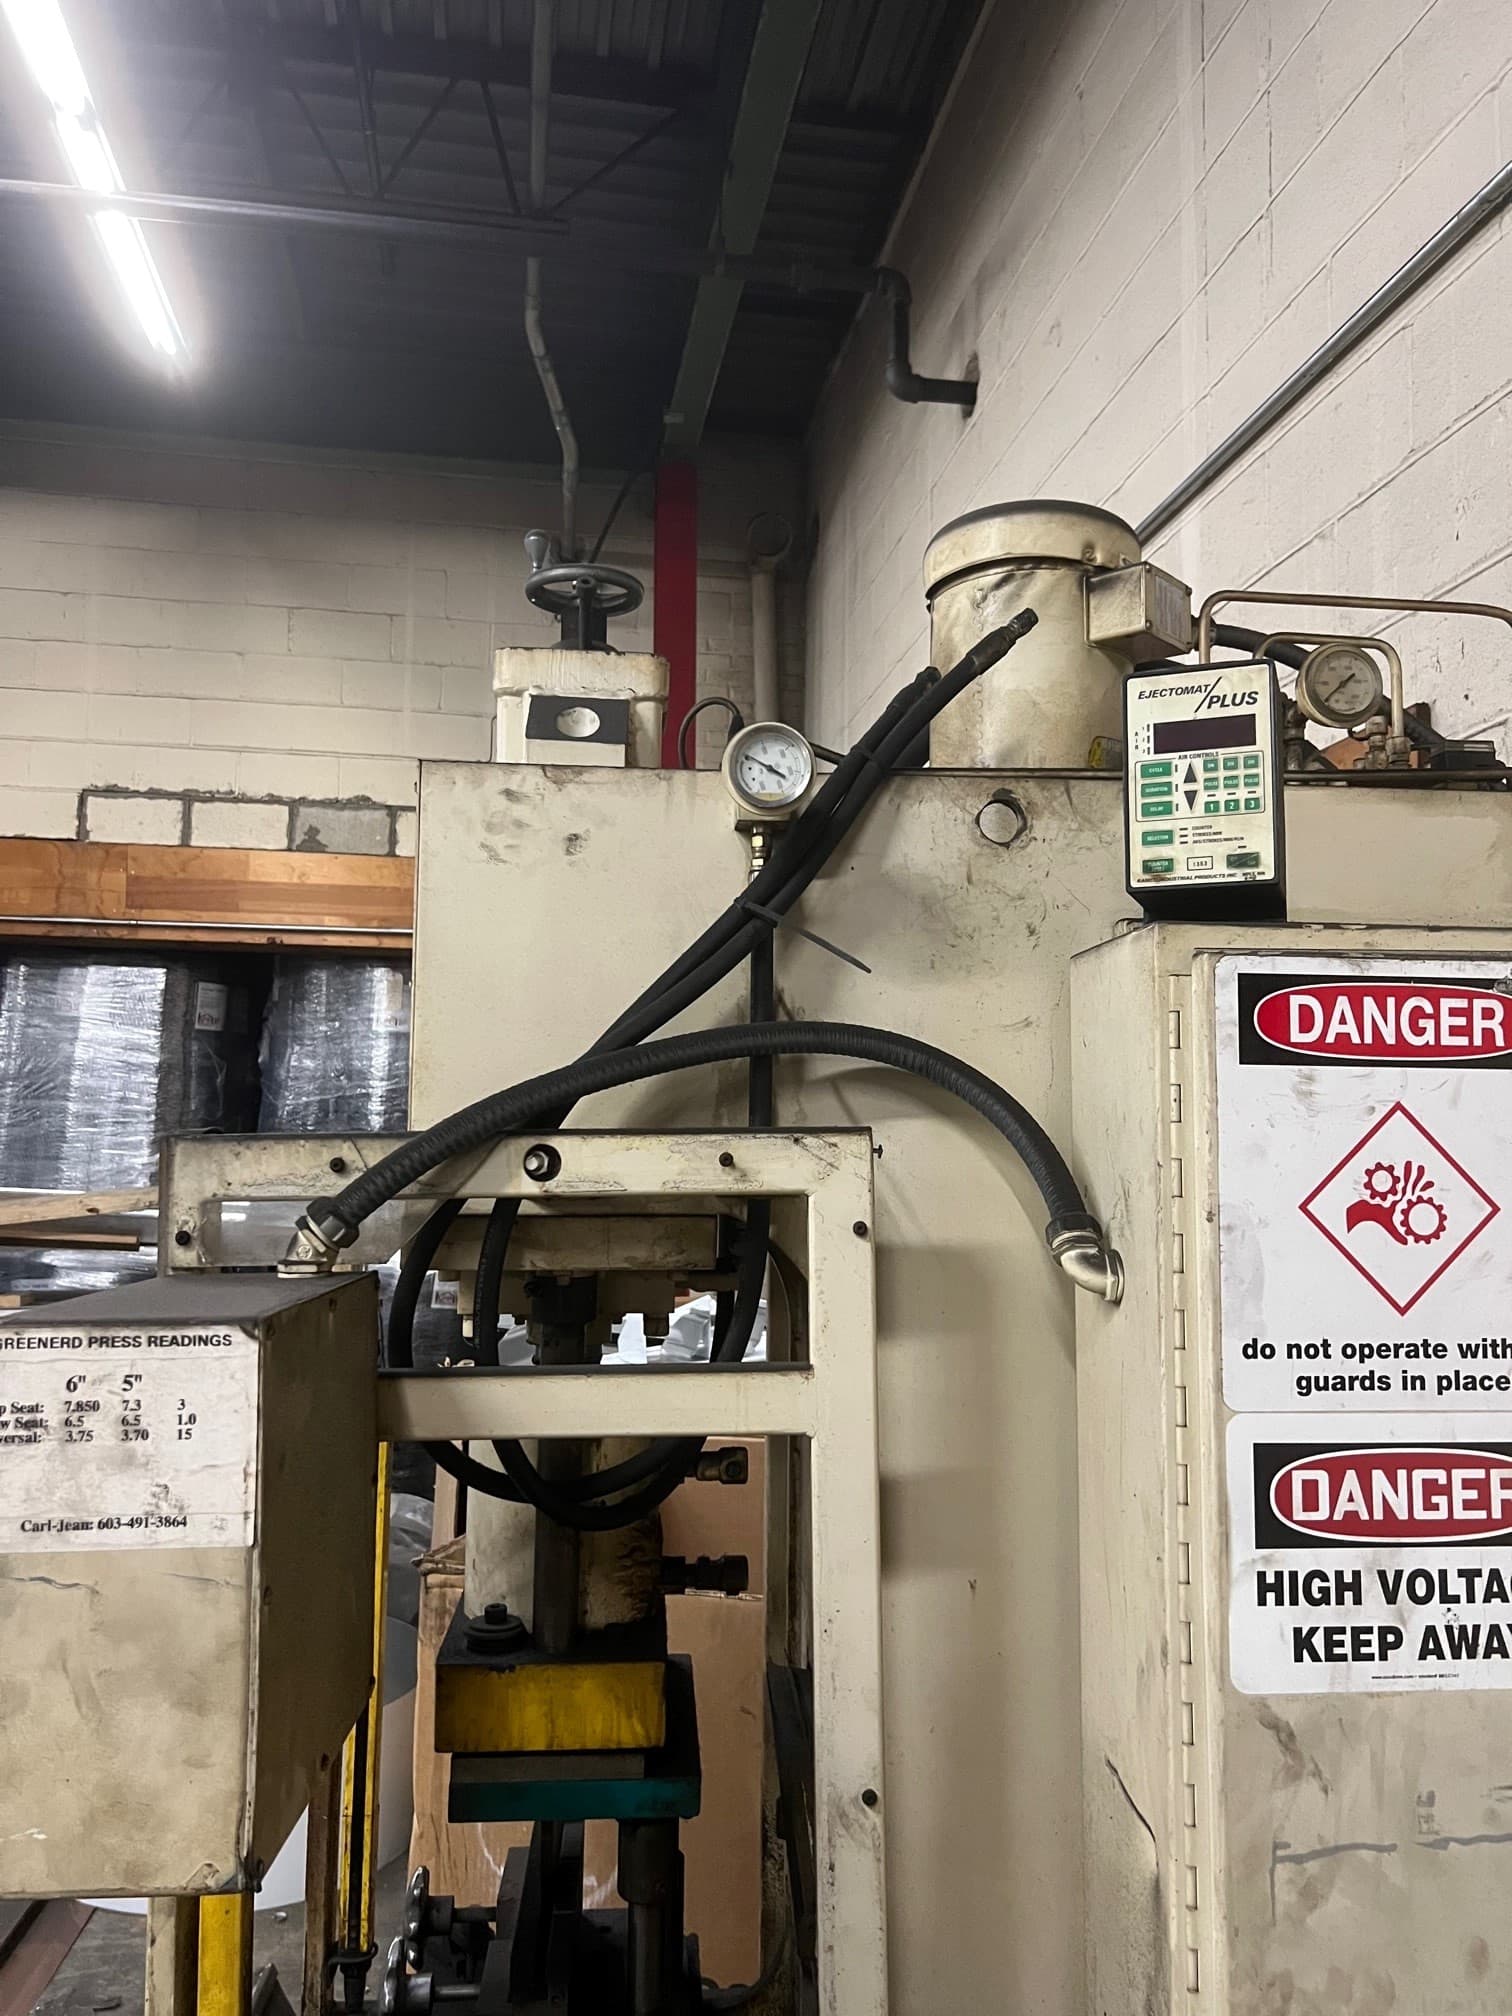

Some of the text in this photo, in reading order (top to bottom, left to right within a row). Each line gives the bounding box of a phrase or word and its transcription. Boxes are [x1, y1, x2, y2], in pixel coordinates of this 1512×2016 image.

[1138, 684, 1211, 700] EJECTOMAT
[1207, 691, 1259, 709] PLUS
[1229, 802, 1234, 810] 2
[1250, 800, 1255, 808] 3
[1289, 994, 1505, 1047] DANGER
[0, 1334, 232, 1350] REENERD PRESS READINGS
[1242, 1337, 1276, 1360] do
[1287, 1338, 1332, 1360] not
[1341, 1338, 1448, 1364] operate
[1296, 1369, 1511, 1397] guards in place
[10, 1401, 45, 1414] Seat:
[64, 1400, 100, 1413] 7.850
[122, 1400, 142, 1412] 7.3
[177, 1398, 186, 1411] 3
[14, 1416, 49, 1430] Seat:
[64, 1415, 85, 1428] 6.5
[121, 1414, 141, 1427] 6.5
[177, 1413, 197, 1426] 1.0
[65, 1430, 94, 1443] 3.75
[121, 1429, 150, 1442] 3.70
[177, 1428, 193, 1441] 15
[20, 1515, 188, 1533] Carl-Jean: 603-491-3864
[1257, 1568, 1512, 1607] HIGH VOLTA
[1293, 1624, 1512, 1663] KEEP AWA
